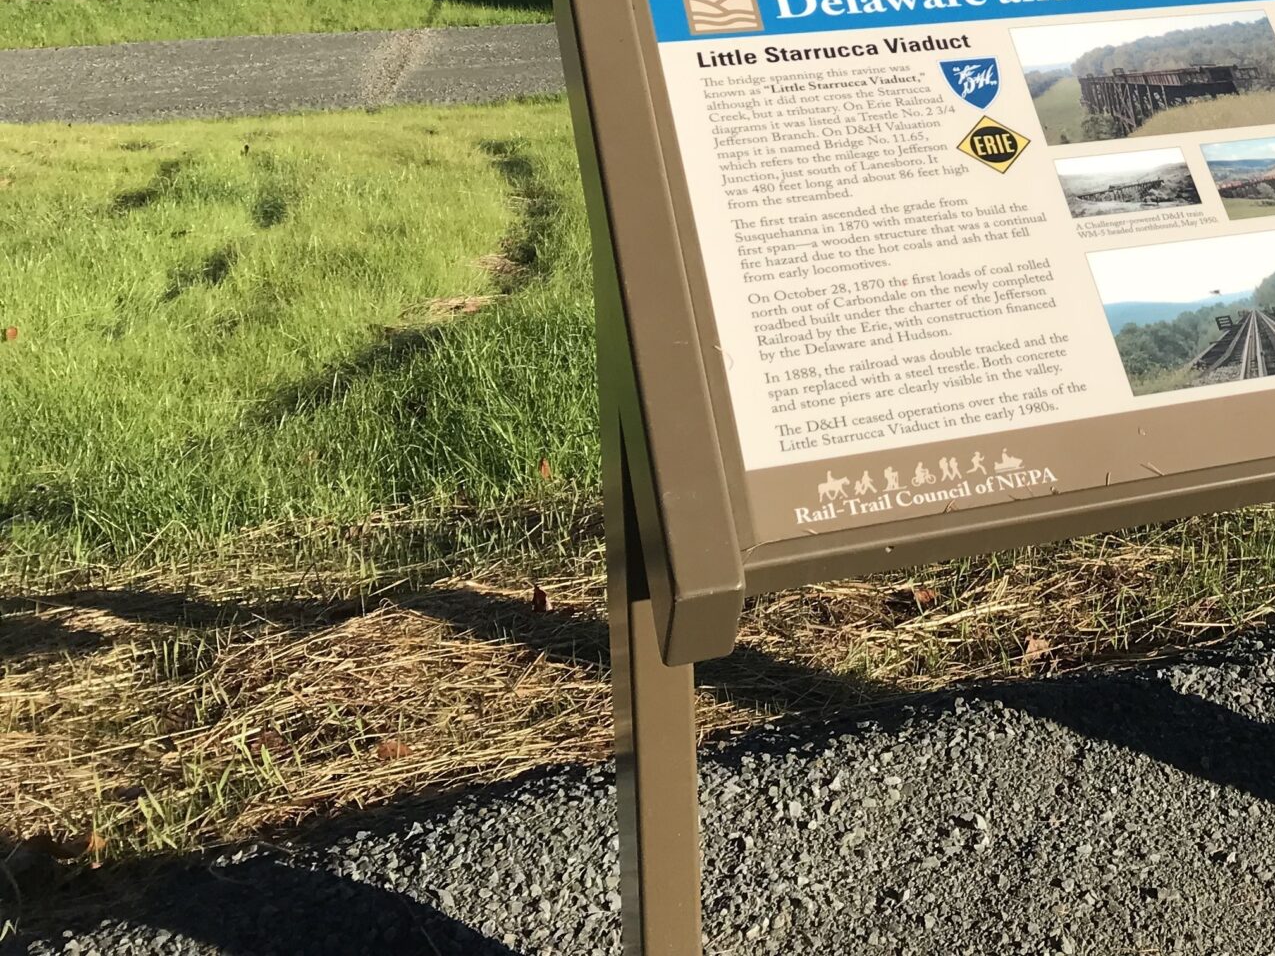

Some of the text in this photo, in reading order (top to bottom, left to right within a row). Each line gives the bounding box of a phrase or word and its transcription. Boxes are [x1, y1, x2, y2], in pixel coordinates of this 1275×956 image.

[696, 35, 971, 68] Little Starrucca Viaduct
[700, 77, 724, 87] The
[727, 74, 766, 86] bridge
[769, 71, 824, 84] spanning
[826, 68, 848, 78] this
[851, 66, 886, 76] ravine
[704, 90, 745, 99] known
[764, 82, 806, 94] “Little
[808, 80, 868, 90] Starrucca
[868, 72, 925, 85] Viaduct,”
[973, 133, 1015, 156] ERIE
[724, 163, 970, 196] was 480 feet long and about 86 feet high
[730, 197, 968, 230] The first train ascended the grade from
[747, 257, 1051, 304] On October 28, 1870 the first loads of coal rolled
[757, 297, 1057, 346] Railroad by the Erie, with construction financed
[759, 328, 952, 363] by the Delaware and Hudson.
[764, 332, 1069, 384] In 1888, the railroad was double tracked and the
[771, 362, 1063, 413] and stone piers are clearly visible in the valley.
[774, 381, 1087, 437] The D&H ceased operations over the rails of the
[779, 401, 1059, 452] Little Starrucca Viaduct in the early 1980s.
[794, 467, 1058, 524] Rail-Trail Council of NEPA
